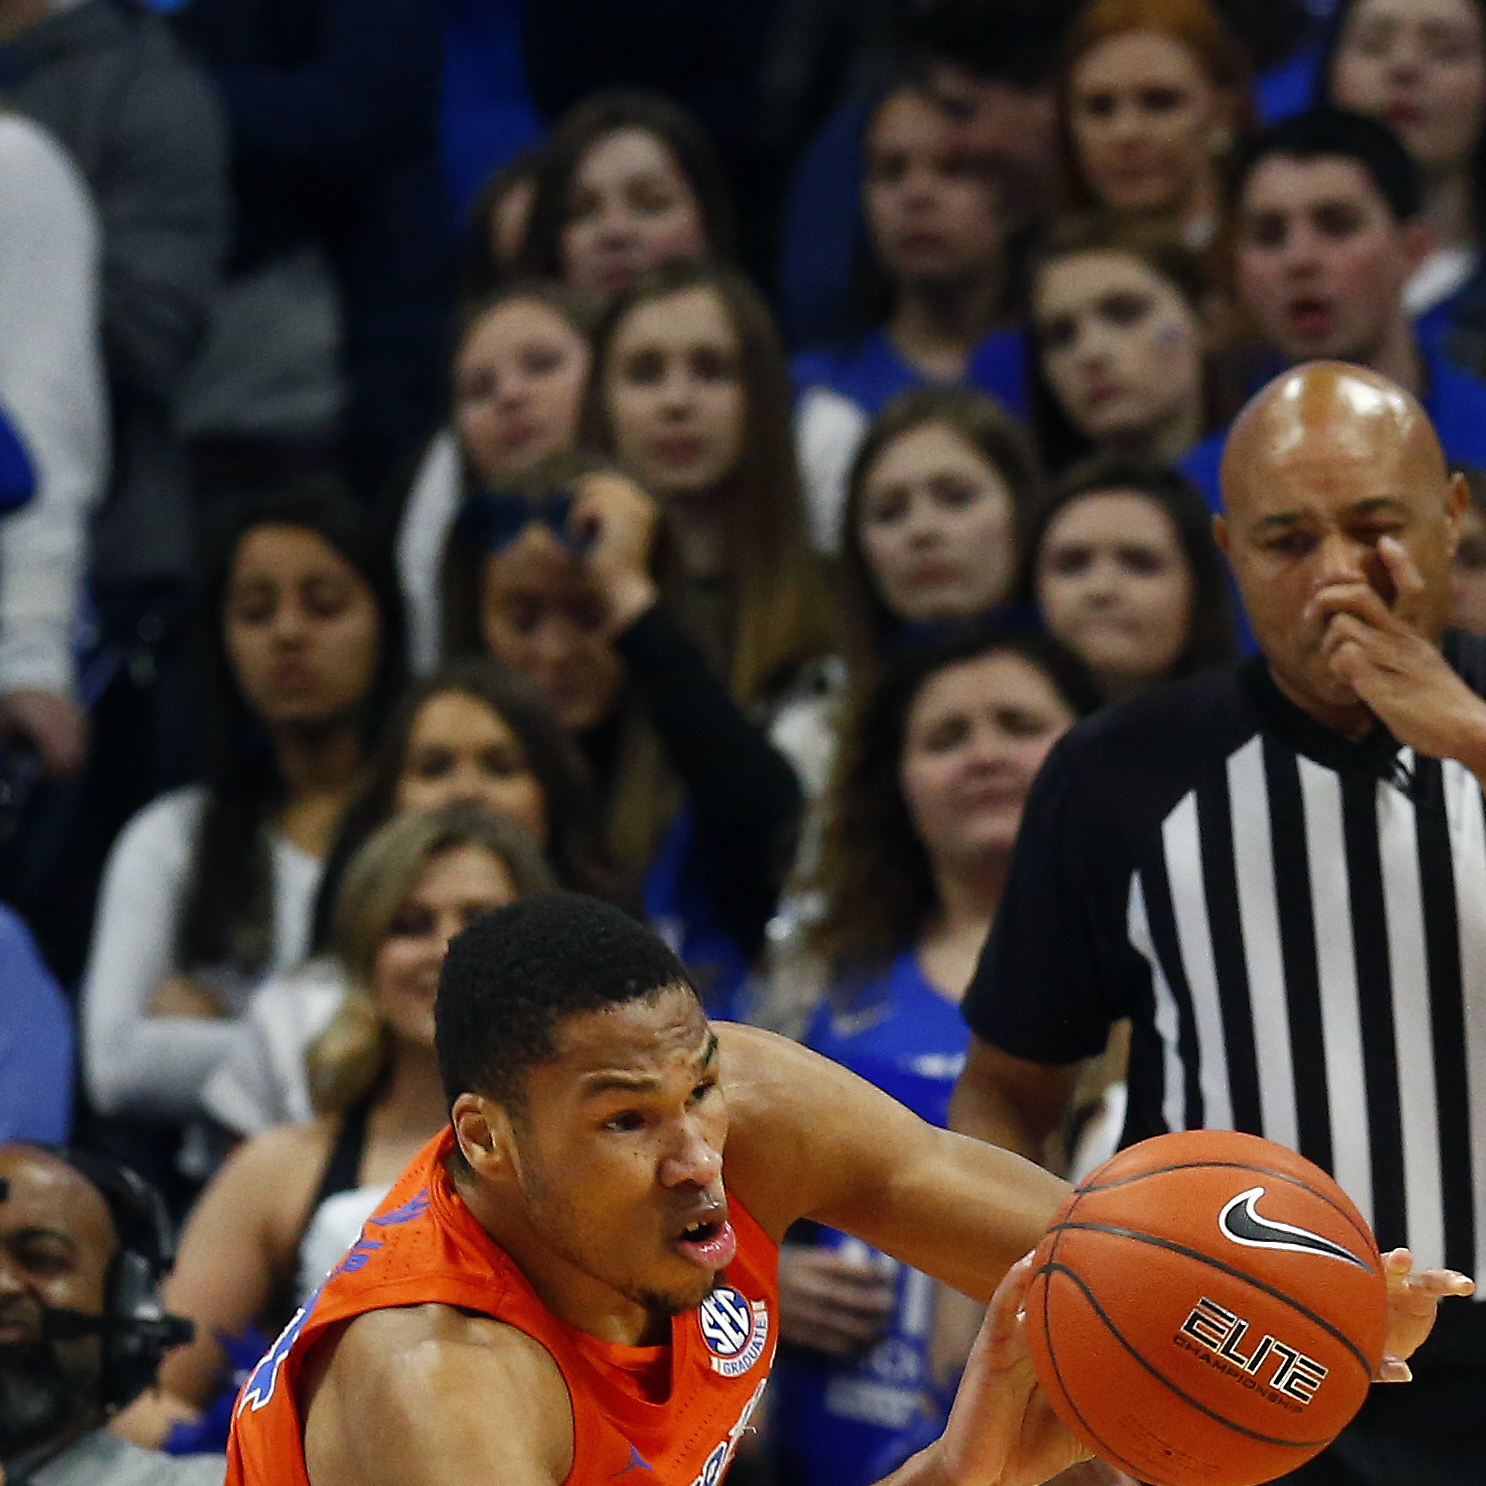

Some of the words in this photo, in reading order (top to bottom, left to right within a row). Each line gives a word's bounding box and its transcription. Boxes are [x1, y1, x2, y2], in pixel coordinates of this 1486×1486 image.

[701, 1287, 751, 1357] SEC
[721, 1316, 768, 1376] GRADUATE
[1180, 1296, 1329, 1405] ELITE
[1172, 1334, 1304, 1414] CHAMPIONSHIP
